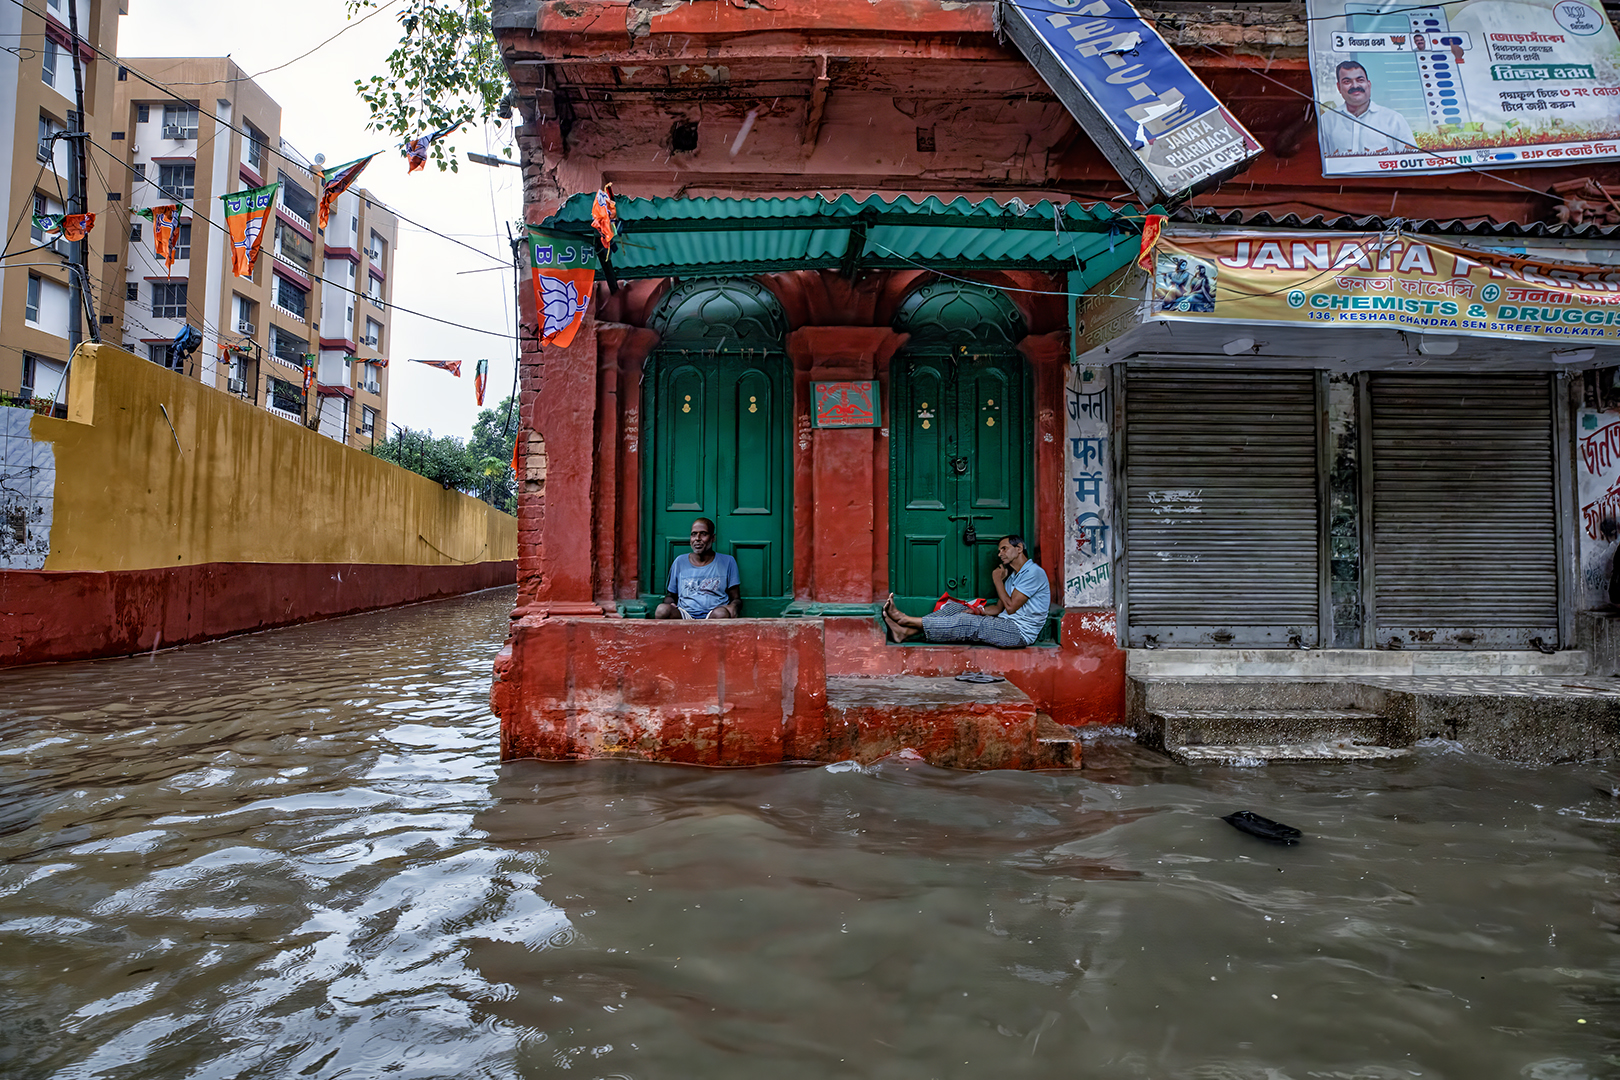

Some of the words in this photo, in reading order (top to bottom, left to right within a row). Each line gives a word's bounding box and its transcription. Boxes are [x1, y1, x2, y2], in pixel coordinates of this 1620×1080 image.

[1335, 36, 1344, 48] 3
[1490, 32, 1565, 44] জোড়াসাঁকো
[1494, 65, 1549, 80] বিজয়
[1553, 68, 1591, 79] ওঝা
[1560, 89, 1570, 97] ৩
[1572, 88, 1590, 97] নং
[1165, 120, 1214, 151] JANATA
[1165, 126, 1233, 167] PHARMACY
[1378, 160, 1398, 170] ভয়
[1400, 158, 1424, 168] OUT
[1459, 155, 1472, 164] IN
[1522, 151, 1544, 160] BJP
[1546, 148, 1563, 157] কে
[1565, 144, 1593, 157] ভোট
[1594, 142, 1617, 155] দিন
[1167, 157, 1216, 186] SUNDAY
[1218, 240, 1437, 276] JANATA
[1335, 275, 1395, 292] জনতা
[1398, 278, 1475, 299] ফার্মেসি
[1505, 287, 1573, 305] जनता
[1310, 293, 1458, 315] CHEMISTS
[1468, 304, 1487, 318] &
[1308, 311, 1335, 322] 136,
[1339, 312, 1396, 321] KESHAB
[1399, 316, 1457, 328] CHANDRA
[1462, 321, 1487, 330] SEN
[1490, 322, 1541, 333] STREET
[1545, 326, 1604, 337] KOLKATA
[1066, 386, 1108, 423] जनता
